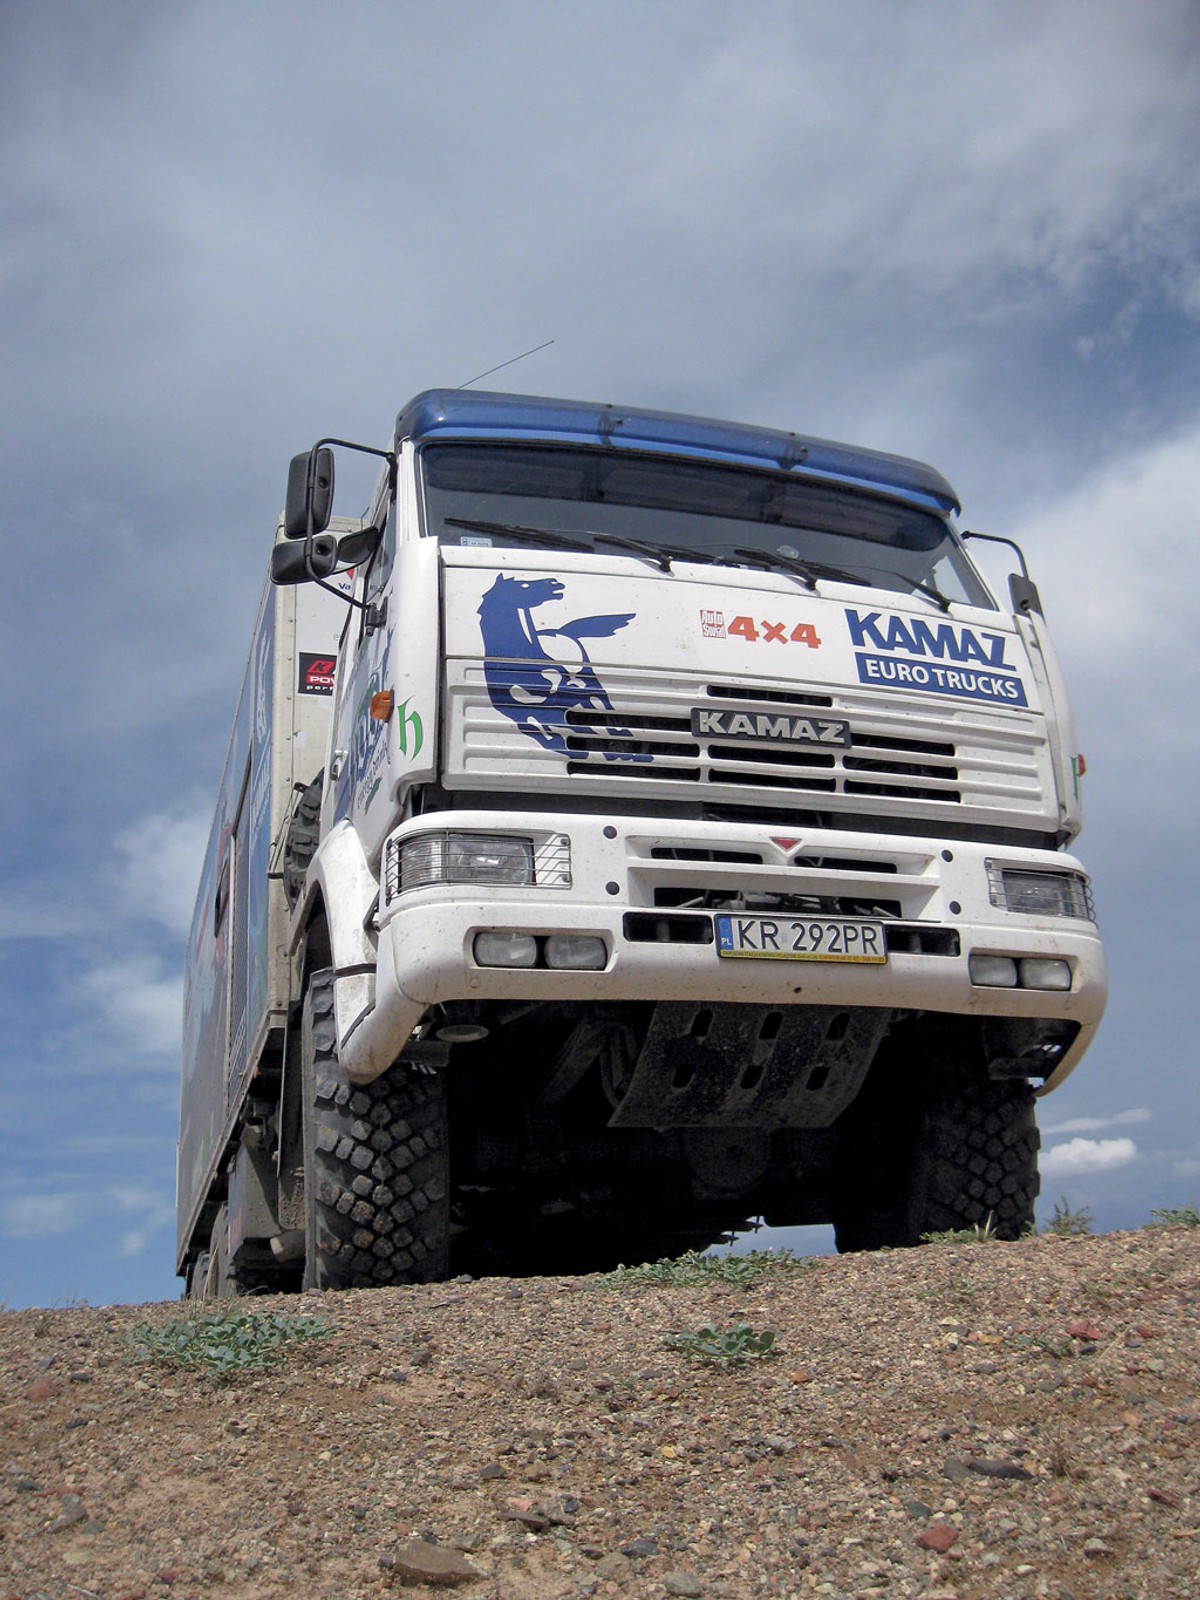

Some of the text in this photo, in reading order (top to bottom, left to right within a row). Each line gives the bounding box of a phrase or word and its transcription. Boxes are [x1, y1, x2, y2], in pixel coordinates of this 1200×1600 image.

[727, 616, 822, 649] 4x4
[844, 608, 1017, 671] KAMAZ
[865, 658, 1019, 699] EURO TRUCKS
[699, 711, 845, 744] KAMAZ
[721, 937, 732, 946] PL
[737, 920, 879, 954] KR 292PR
